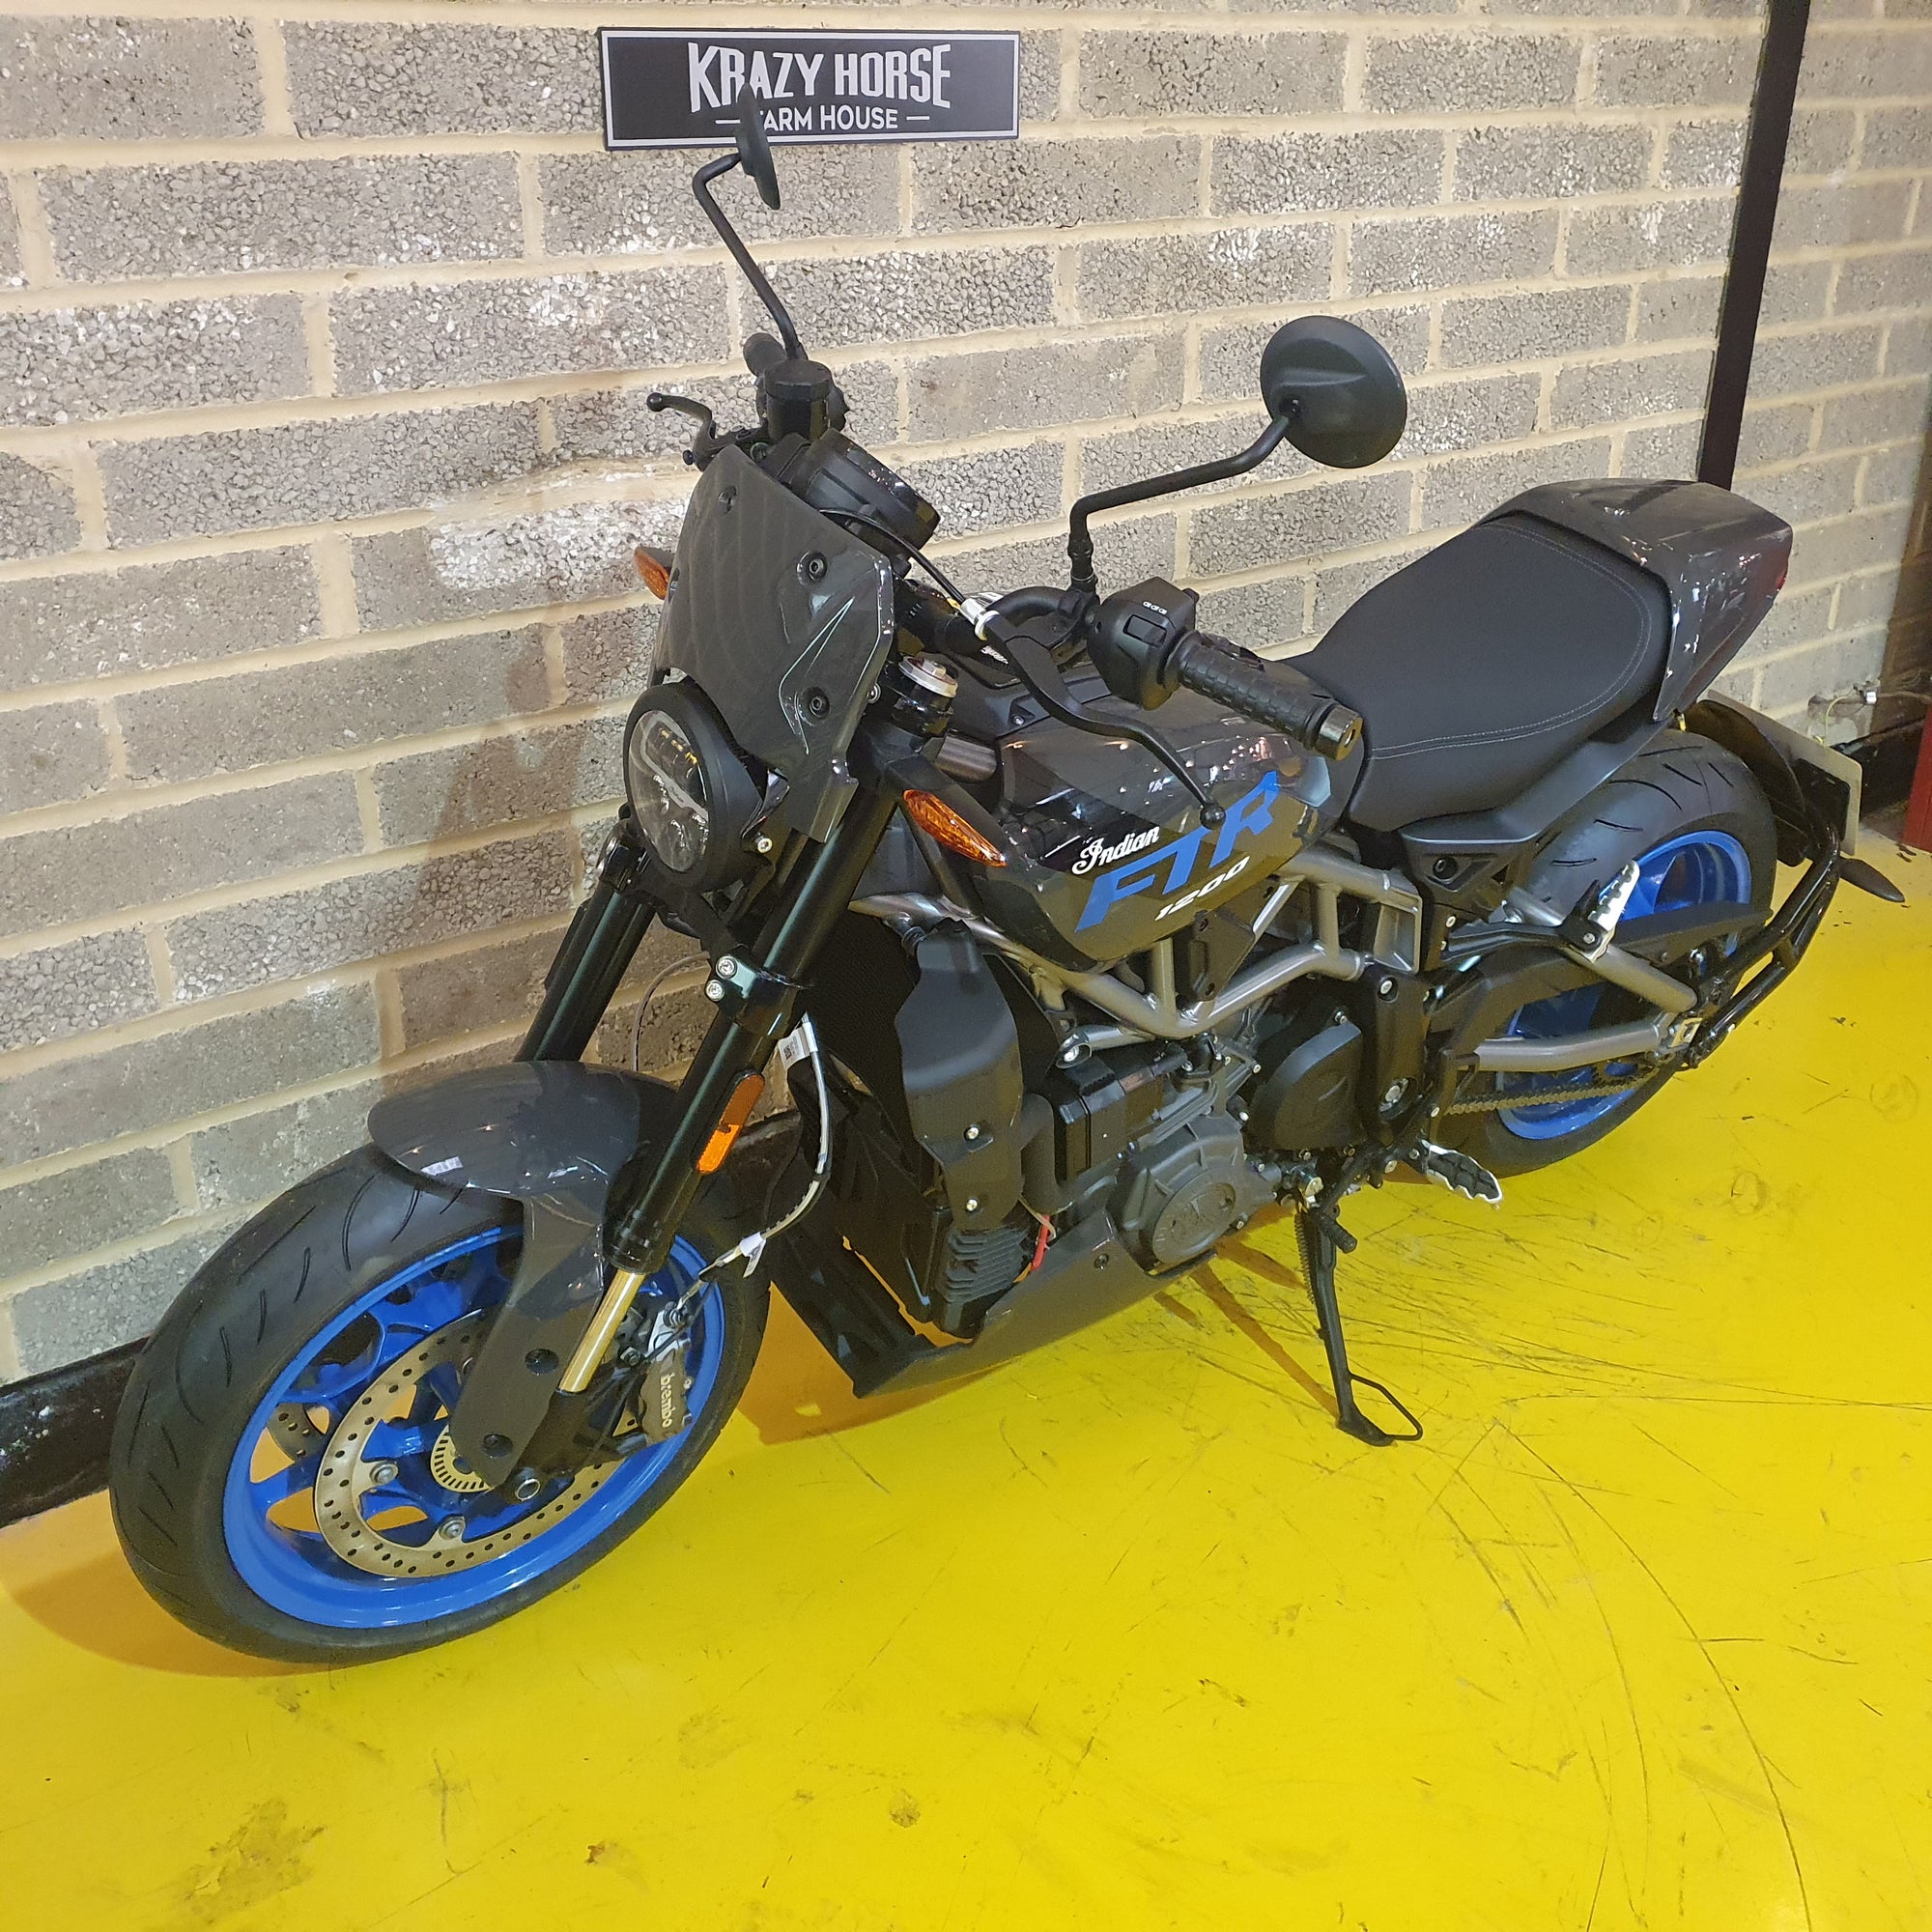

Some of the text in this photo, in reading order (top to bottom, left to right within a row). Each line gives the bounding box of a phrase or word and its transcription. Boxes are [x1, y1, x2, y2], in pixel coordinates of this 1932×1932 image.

[688, 42, 952, 113] KRAZY HORSE
[758, 104, 898, 131] ARM HOUSE
[1071, 826, 1160, 875] Indian
[1074, 770, 1280, 933] FTR
[1154, 855, 1251, 922] 1200
[660, 1372, 676, 1428] brembo
